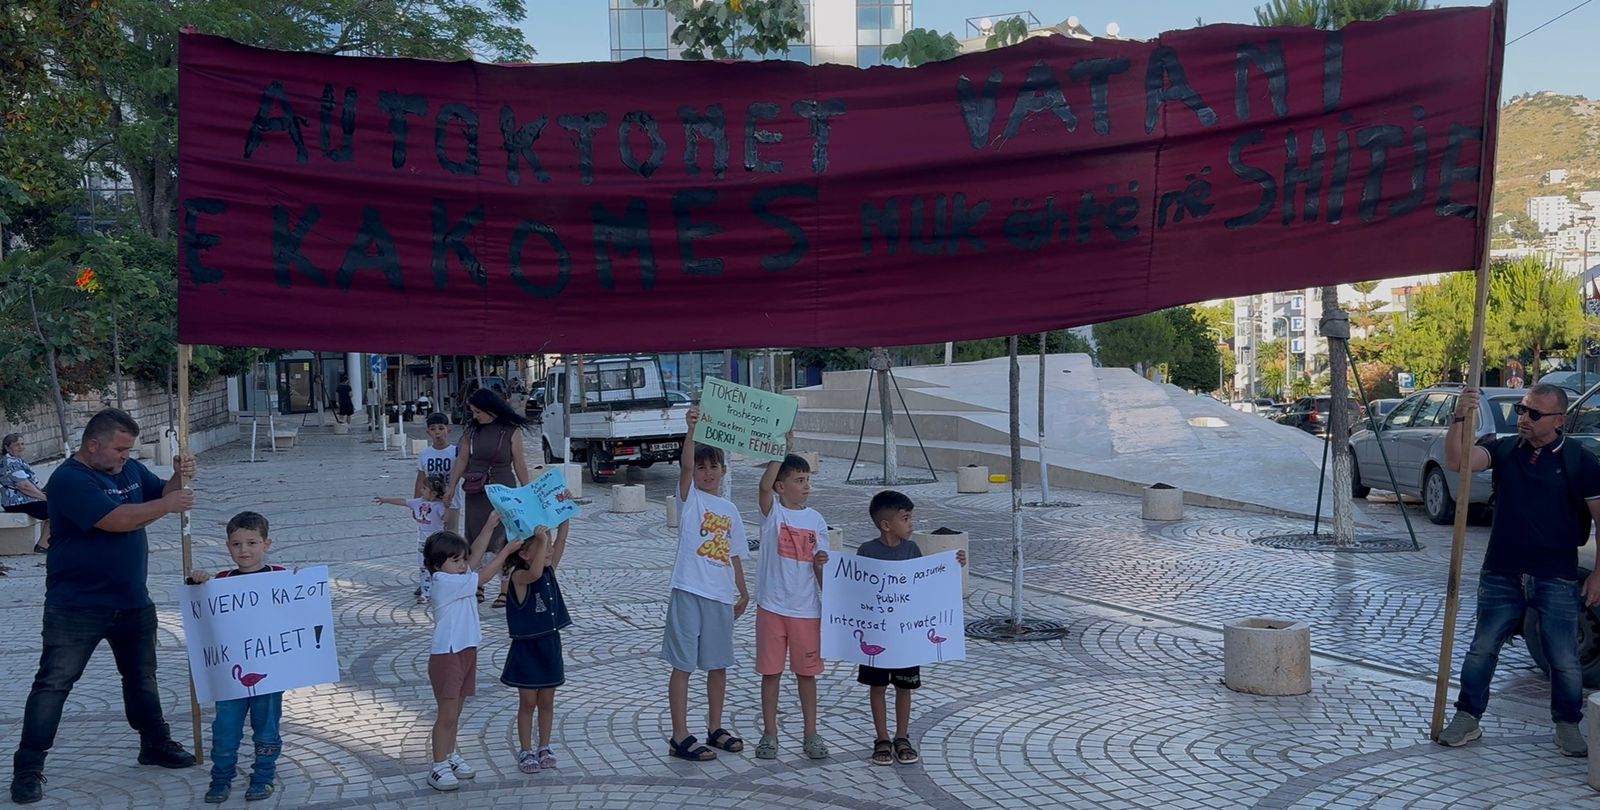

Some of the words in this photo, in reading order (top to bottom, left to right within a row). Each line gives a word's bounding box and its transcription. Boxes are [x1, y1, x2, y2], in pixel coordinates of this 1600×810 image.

[183, 199, 227, 287] E
[271, 184, 818, 299] KAKOMES
[1402, 373, 1412, 388] P
[709, 381, 747, 404] TOKËN
[705, 426, 736, 445] BORXH
[427, 457, 451, 472] BRO
[208, 590, 259, 616] VEND
[271, 581, 328, 604] KAZOT
[203, 644, 230, 668] NUK
